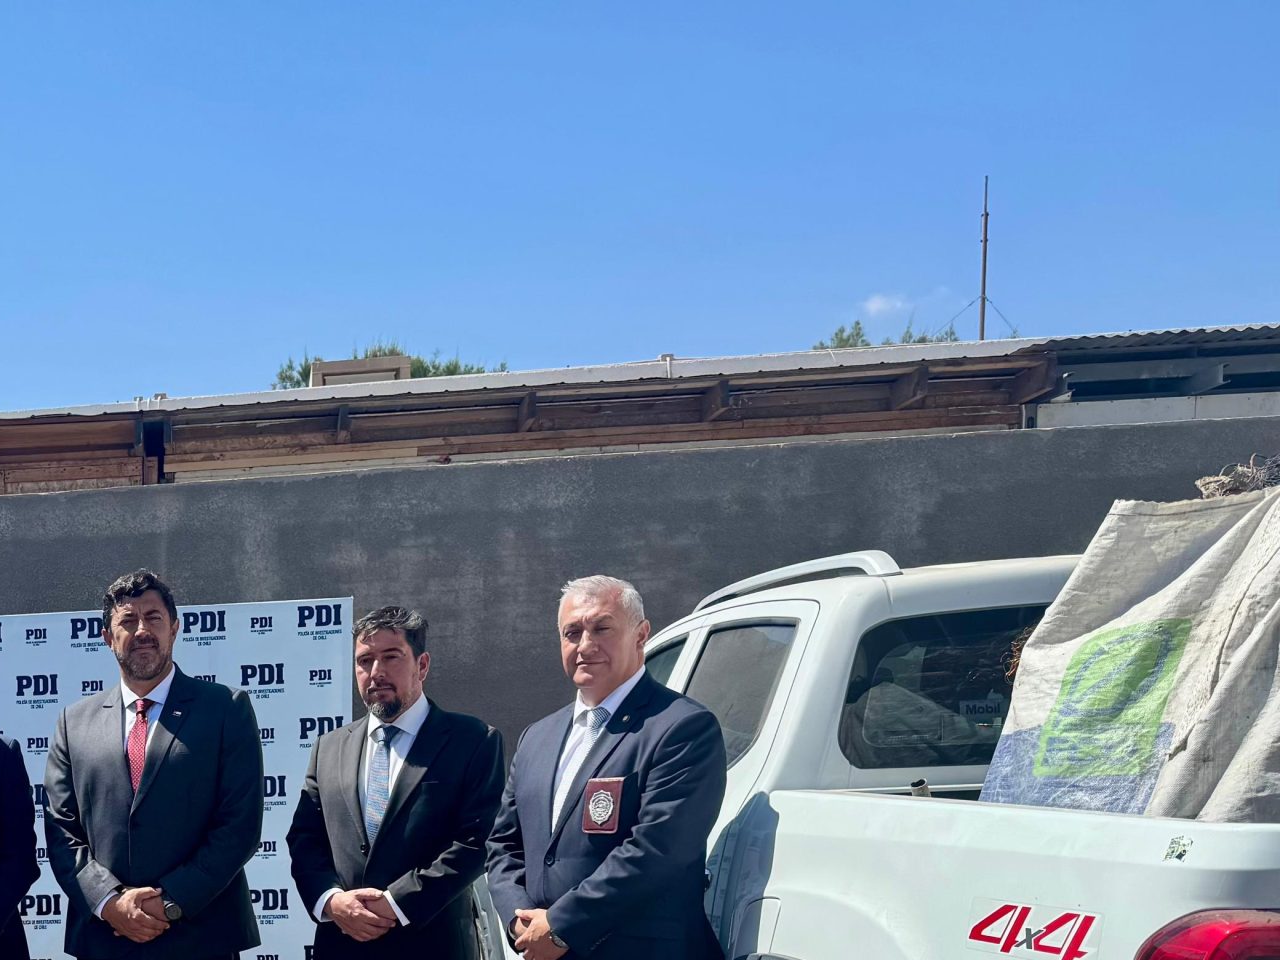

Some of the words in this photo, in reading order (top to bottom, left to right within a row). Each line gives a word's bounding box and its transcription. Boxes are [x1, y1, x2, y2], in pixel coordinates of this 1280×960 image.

[183, 610, 226, 633] PDI
[250, 616, 273, 629] PDI
[298, 604, 342, 627] PDI
[26, 628, 47, 640] PDI
[70, 617, 104, 639] PD
[16, 674, 58, 696] PDI
[240, 662, 285, 686] PDI
[309, 669, 332, 681] PDI
[82, 680, 103, 692] PDI
[965, 703, 1000, 715] Mobil
[27, 737, 49, 749] PDI
[264, 775, 287, 797] DI
[20, 894, 61, 916] PDI
